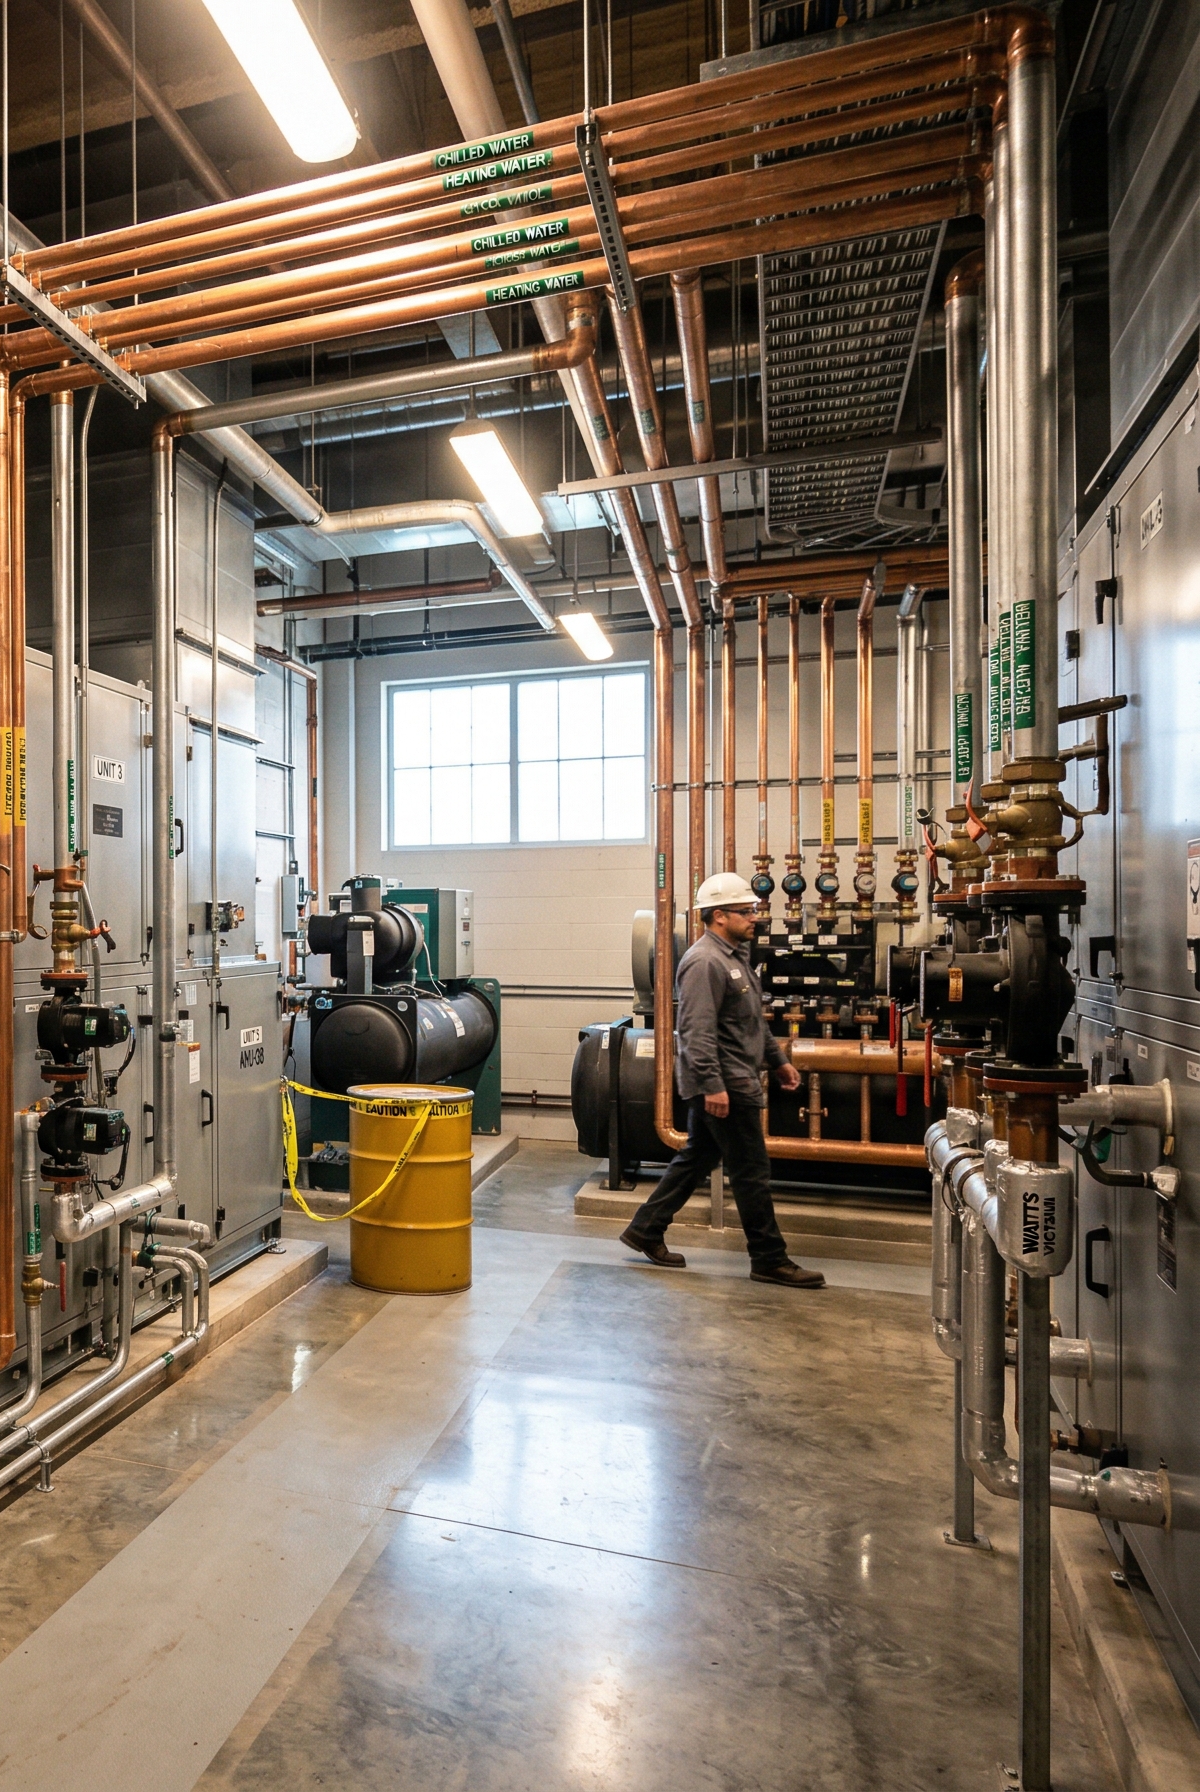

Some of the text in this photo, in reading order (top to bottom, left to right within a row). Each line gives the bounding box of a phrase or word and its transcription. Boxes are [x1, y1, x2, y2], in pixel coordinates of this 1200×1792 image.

[437, 134, 530, 167] CHILLED WATER
[446, 165, 497, 188] HEATING
[473, 221, 564, 251] CHILLED WATER
[492, 273, 579, 301] HEATING WATER
[97, 759, 123, 780] UNIT 3
[1022, 1191, 1039, 1255] WATTS
